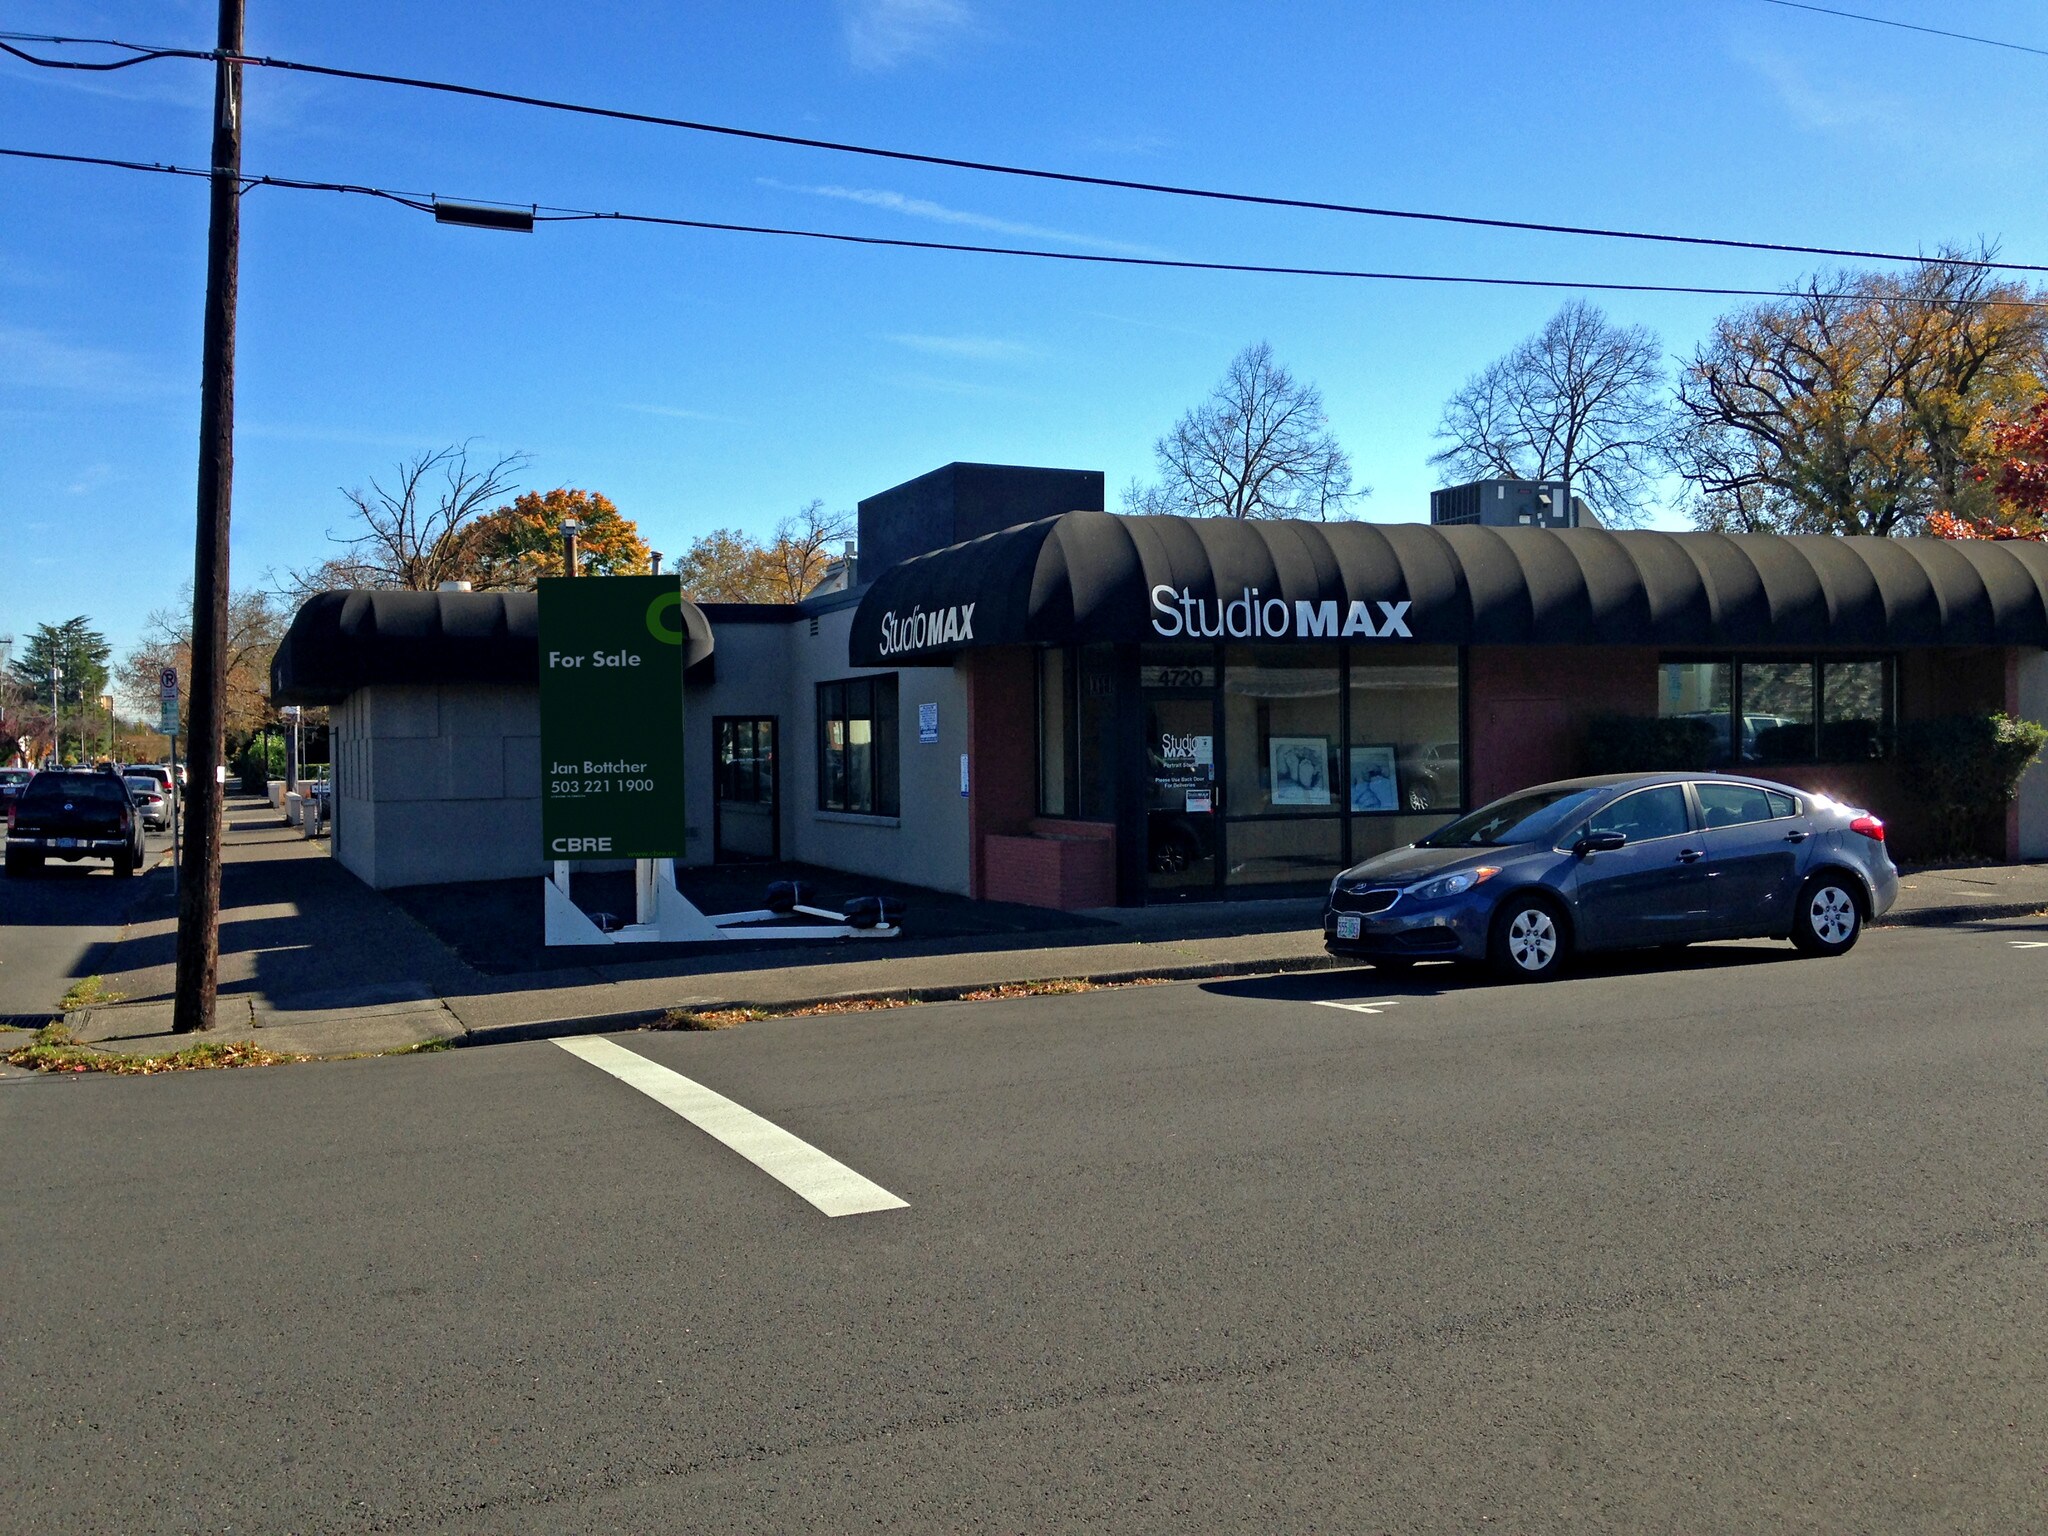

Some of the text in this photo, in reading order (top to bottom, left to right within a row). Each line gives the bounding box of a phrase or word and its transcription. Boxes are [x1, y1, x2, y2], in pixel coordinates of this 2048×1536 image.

[549, 649, 642, 669] For Sale
[1158, 669, 1203, 686] 4720
[1161, 733, 1199, 751] Studio
[1163, 748, 1197, 758] MAX
[550, 759, 648, 775] Jan Bottcher
[551, 779, 654, 793] 503 221 1900
[551, 837, 612, 853] CBRE
